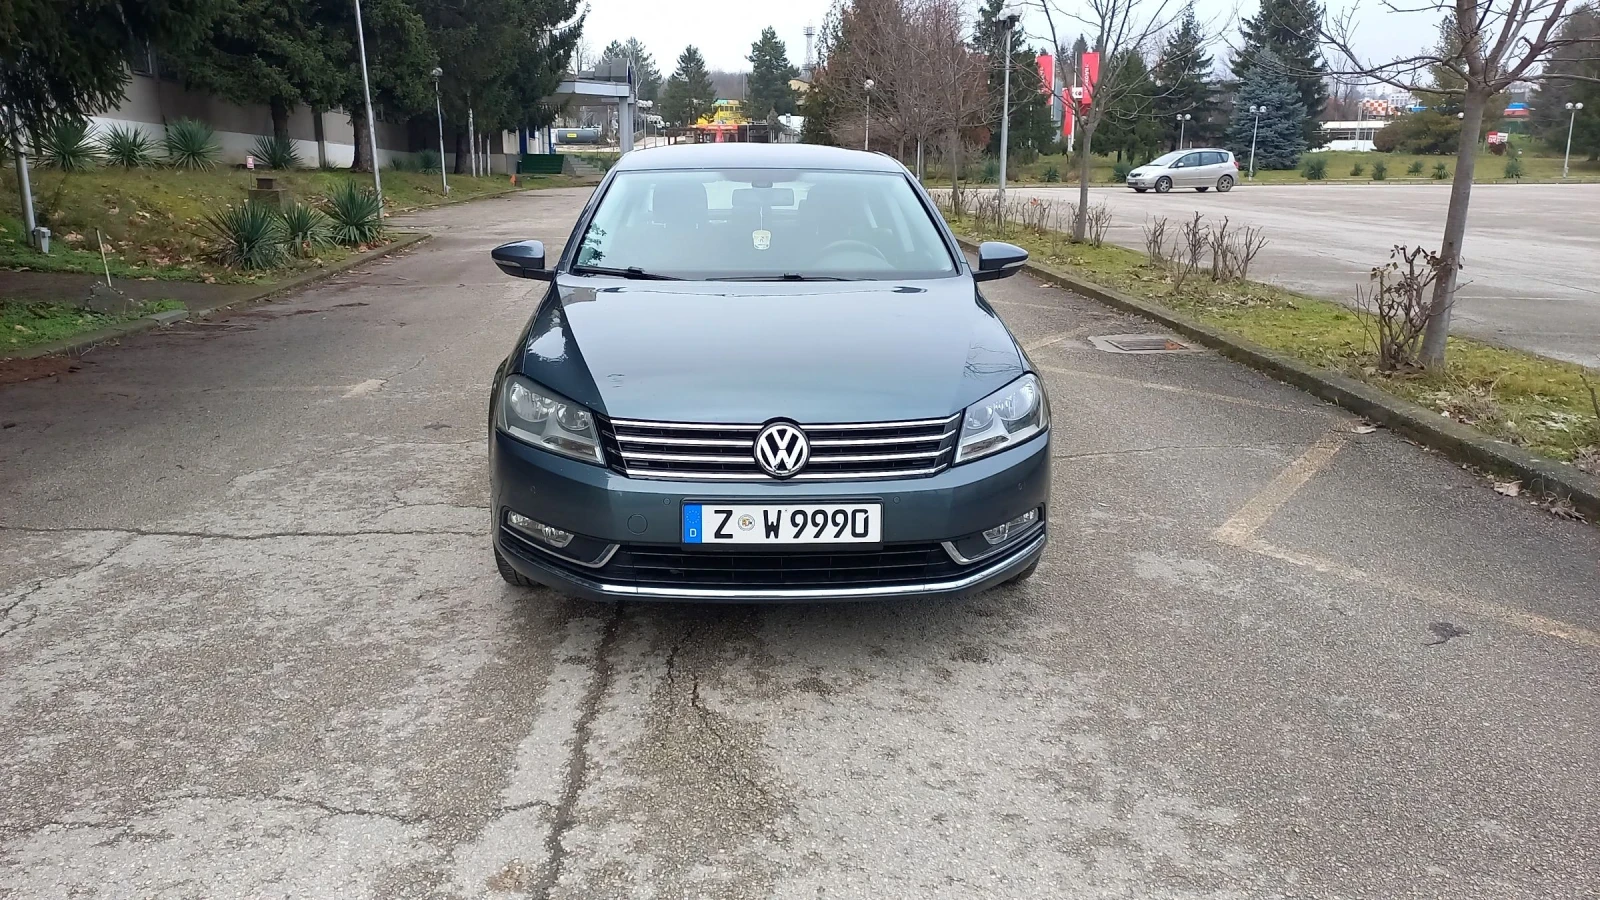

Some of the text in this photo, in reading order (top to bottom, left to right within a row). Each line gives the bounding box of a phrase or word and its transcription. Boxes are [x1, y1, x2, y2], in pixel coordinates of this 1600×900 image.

[758, 424, 807, 474] VW
[689, 528, 697, 537] D
[714, 510, 733, 539] Z
